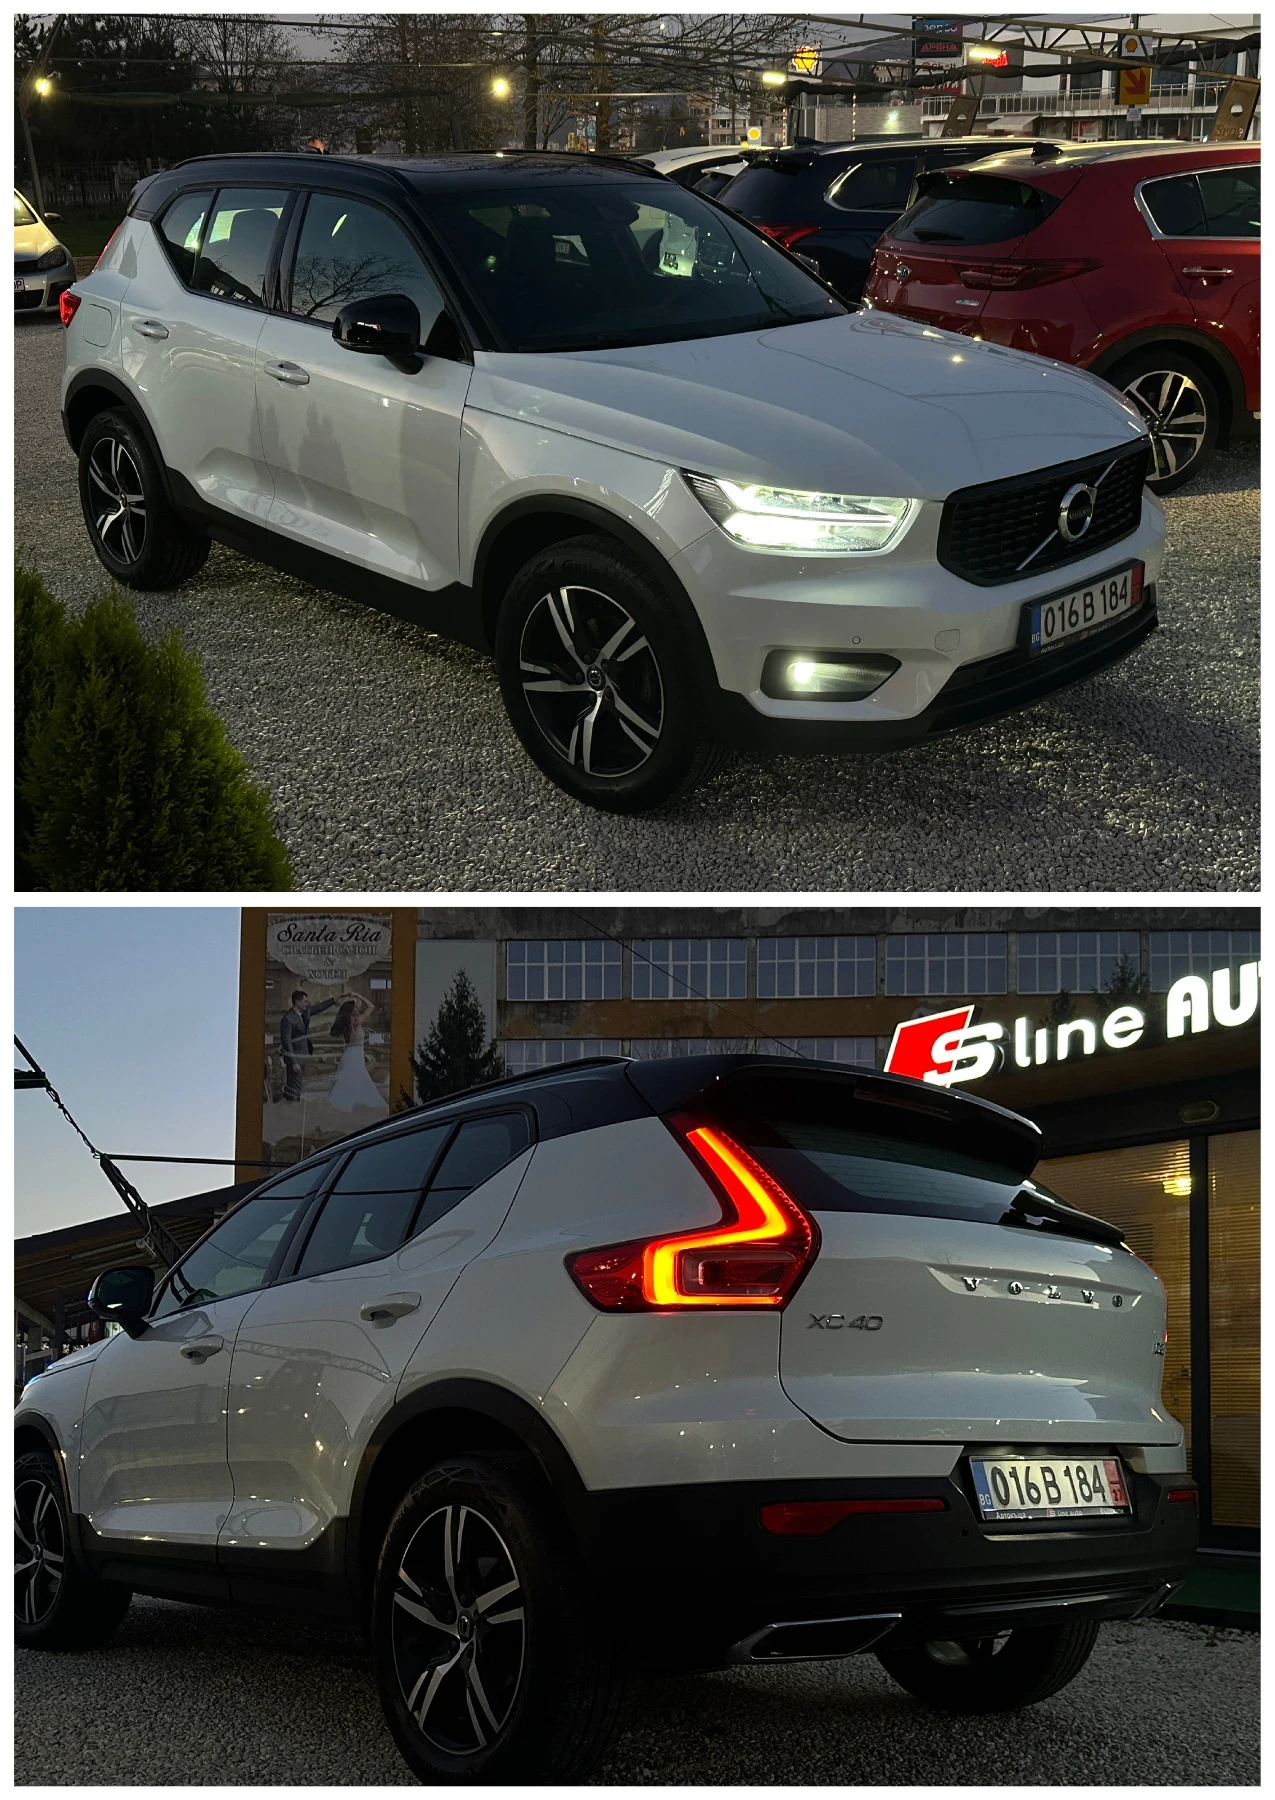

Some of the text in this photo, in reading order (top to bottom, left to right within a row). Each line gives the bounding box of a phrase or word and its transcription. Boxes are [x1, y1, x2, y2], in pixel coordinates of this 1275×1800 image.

[1043, 596, 1080, 638] 016
[1083, 591, 1095, 624] B
[1100, 575, 1128, 615] 184
[1031, 632, 1040, 644] BG
[277, 923, 382, 942] Santa Ria
[324, 958, 334, 966] &
[1014, 1006, 1145, 1068] line
[1167, 961, 1261, 1039] AU
[962, 1276, 1123, 1308] VOLVO
[990, 1465, 1107, 1506] 016 B 184
[978, 1493, 992, 1506] BG
